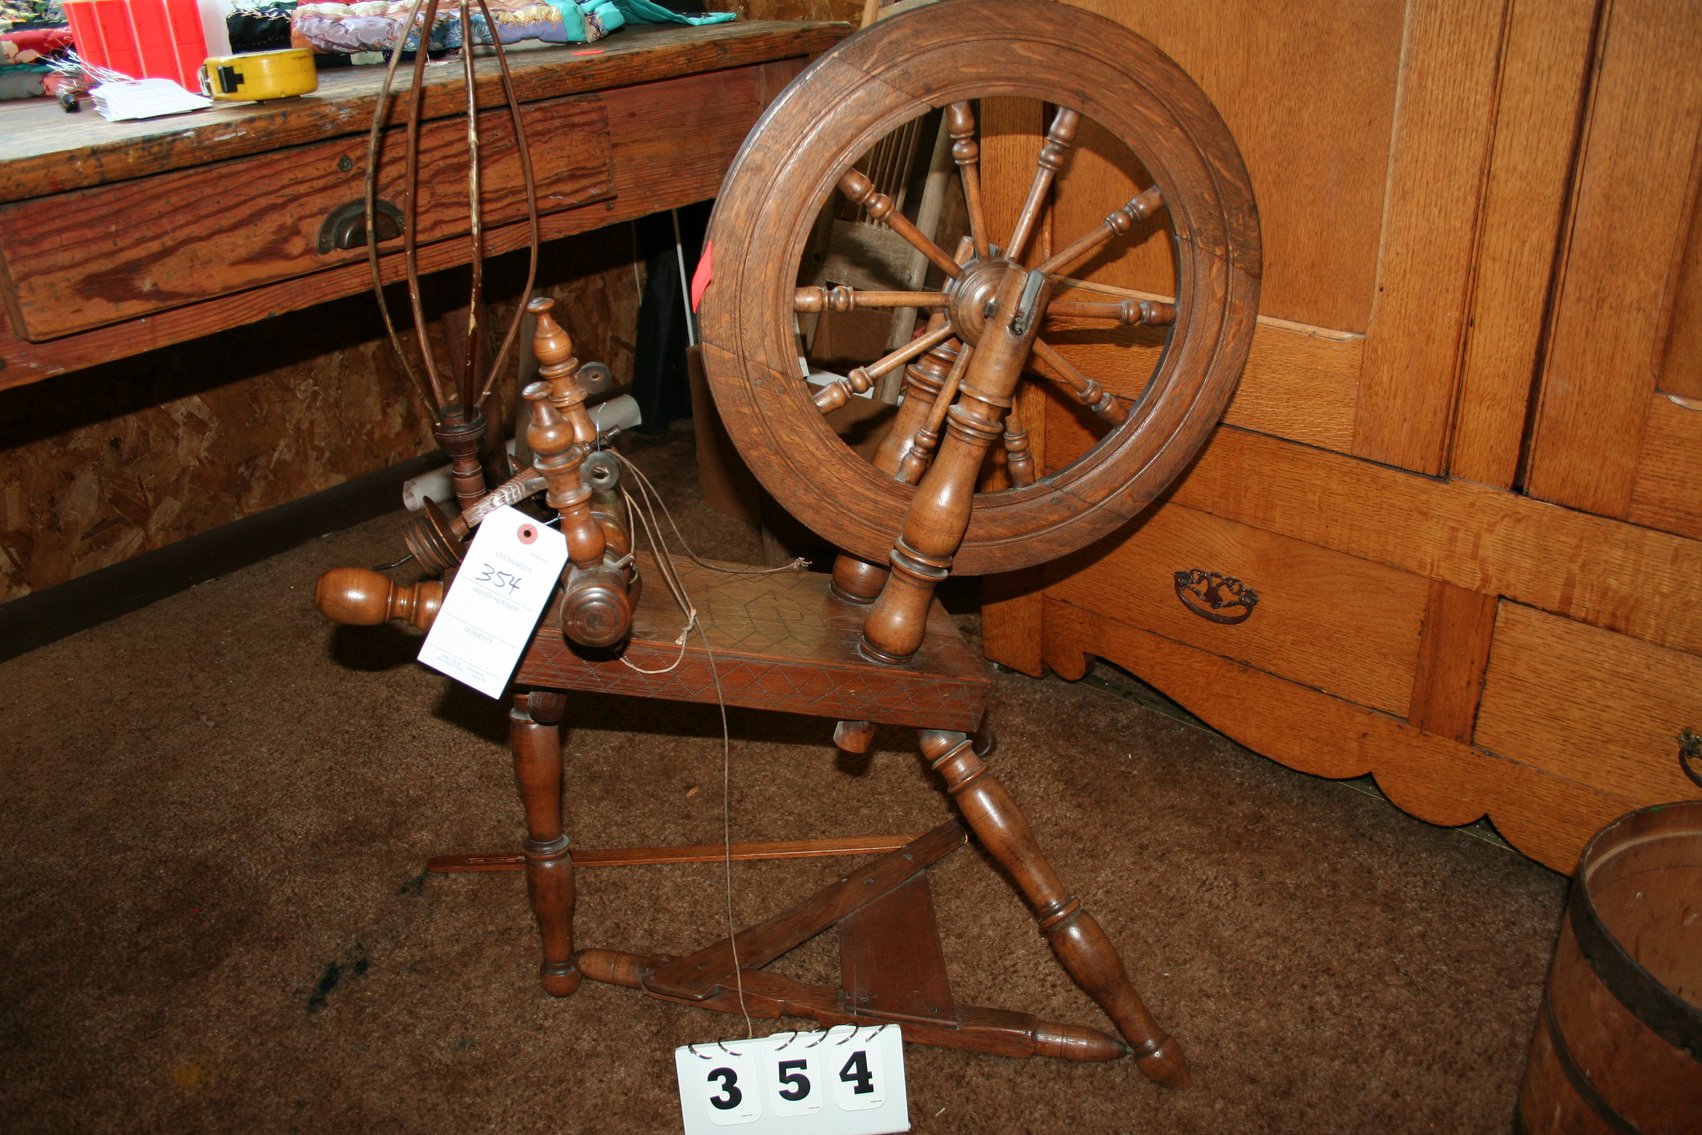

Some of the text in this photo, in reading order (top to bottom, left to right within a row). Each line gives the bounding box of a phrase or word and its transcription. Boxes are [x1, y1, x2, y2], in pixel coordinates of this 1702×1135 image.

[475, 563, 522, 596] 354
[493, 596, 519, 614] NUMBER
[463, 626, 493, 644] QUANTITY
